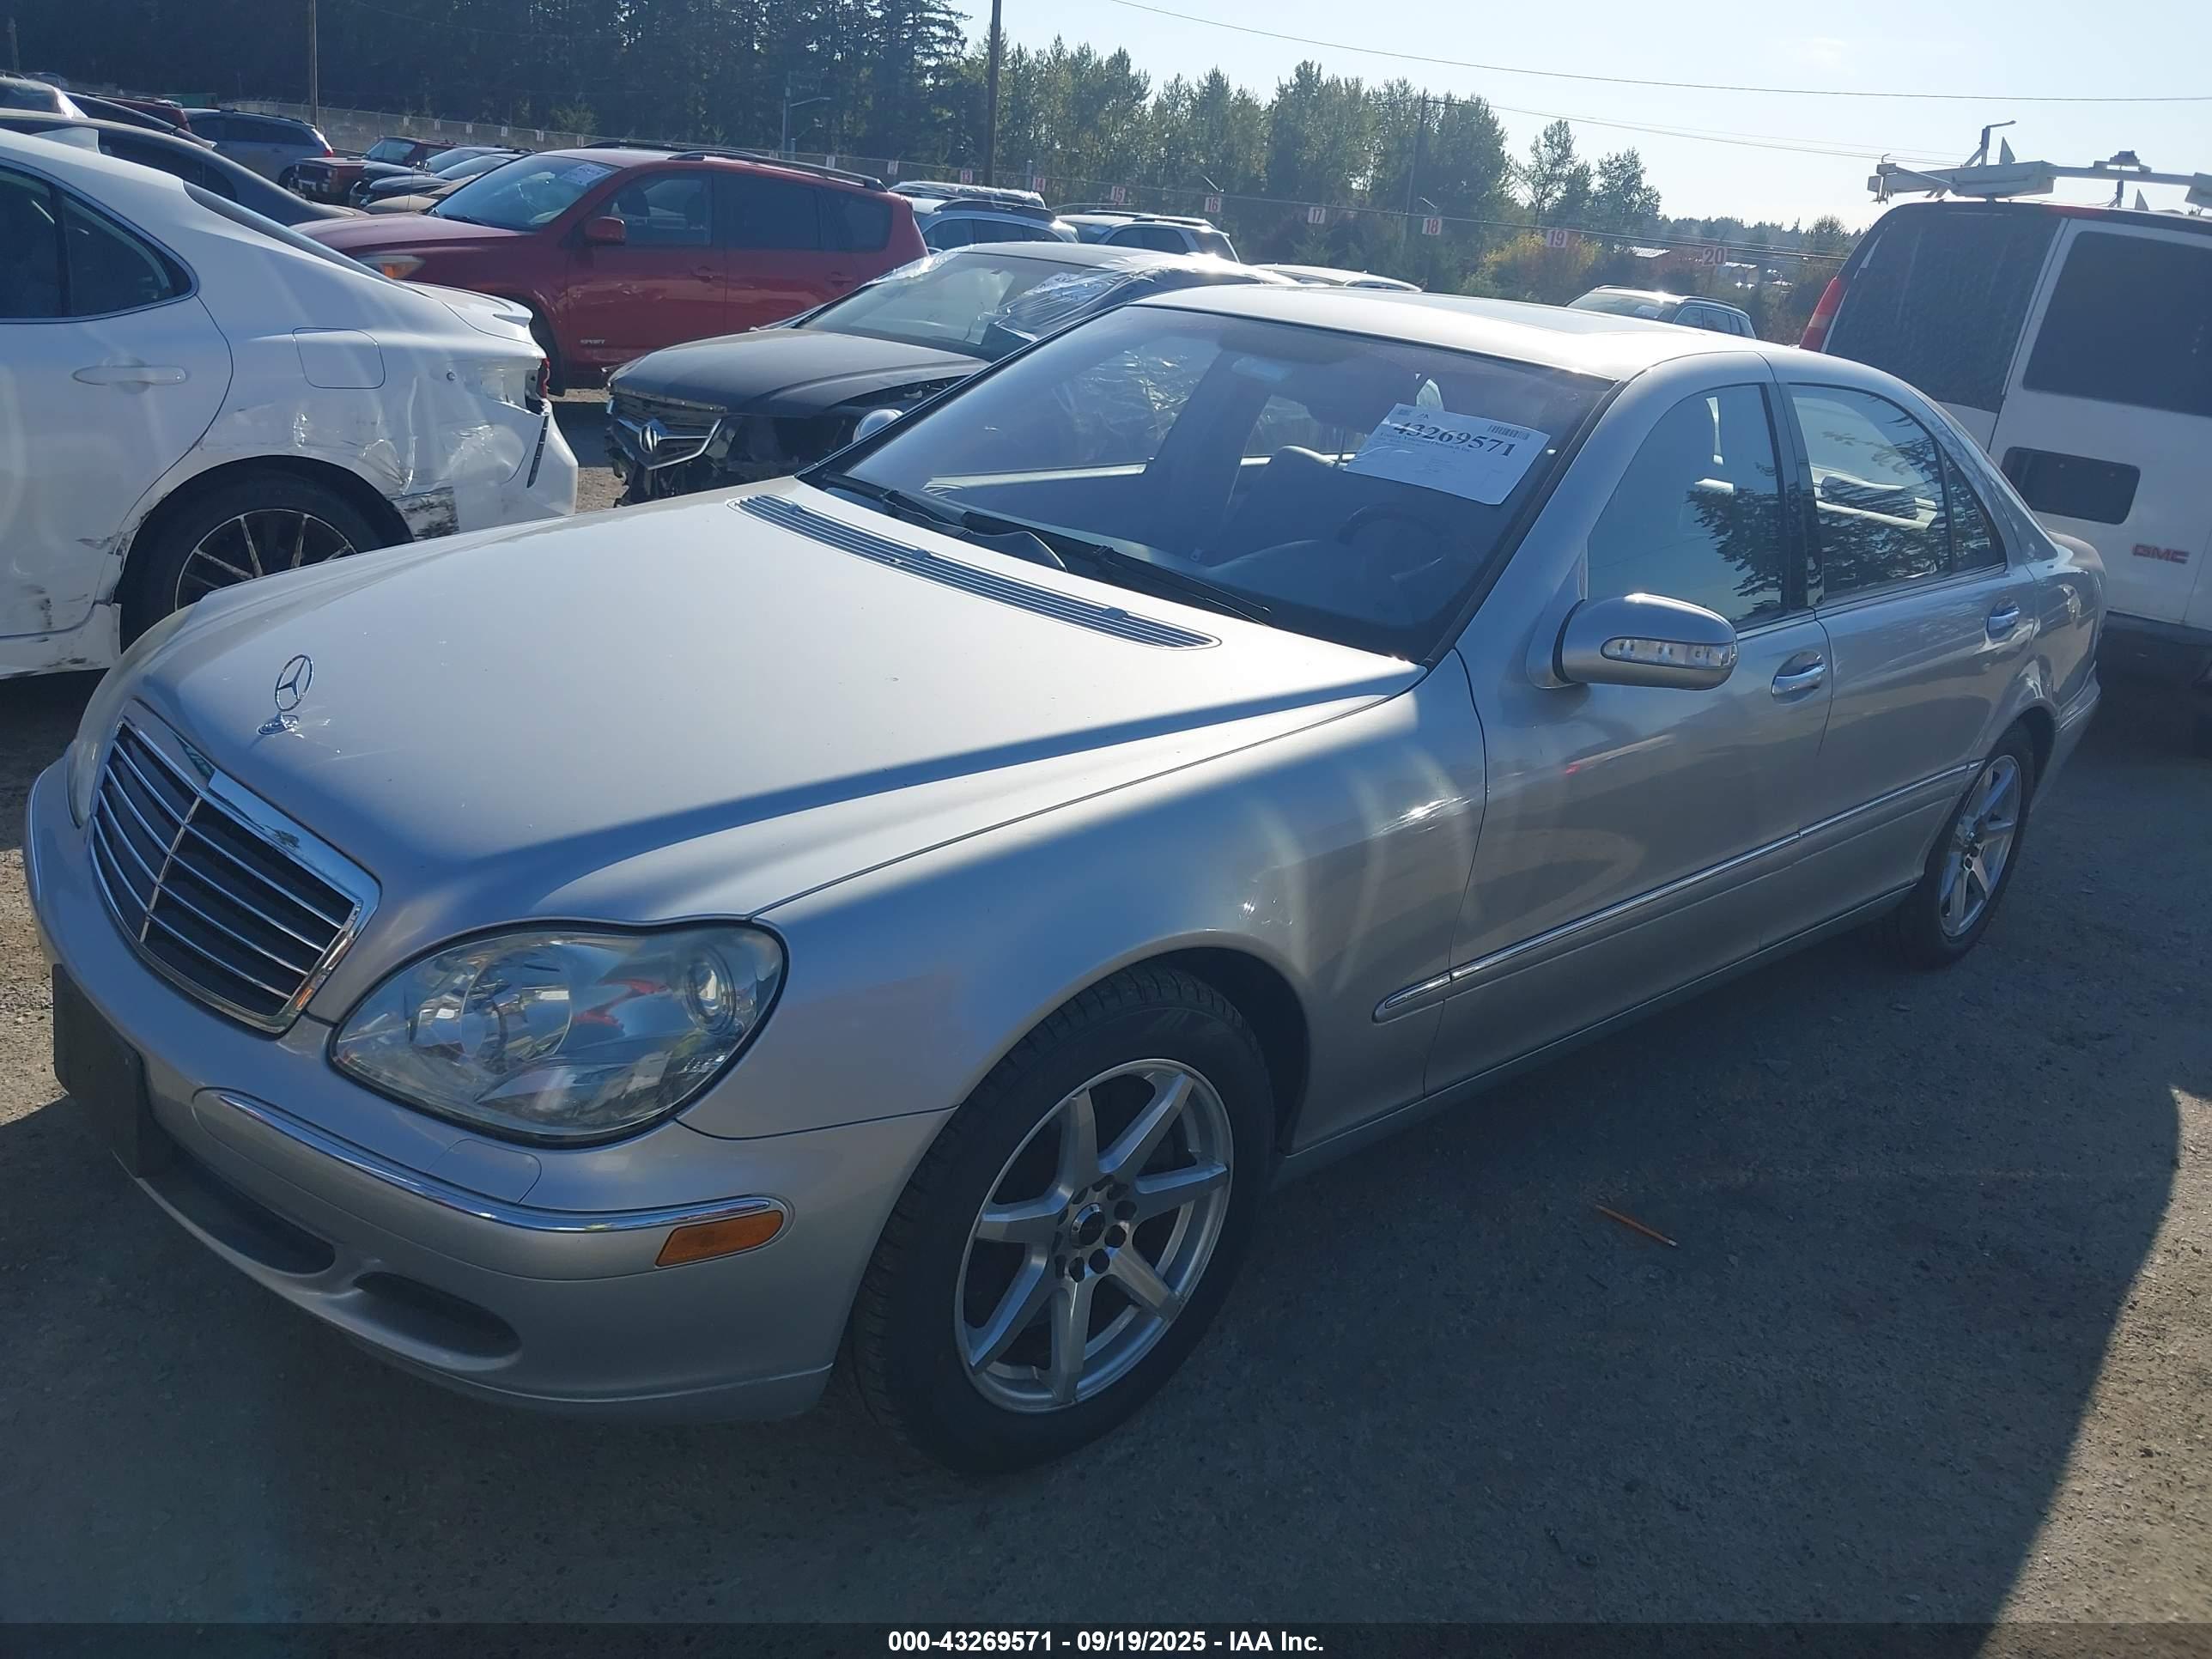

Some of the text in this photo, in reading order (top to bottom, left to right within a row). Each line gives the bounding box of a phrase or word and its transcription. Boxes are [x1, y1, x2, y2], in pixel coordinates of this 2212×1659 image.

[1113, 188, 1124, 202] 15
[1208, 198, 1218, 212] 16
[1311, 209, 1323, 222] 17
[1426, 219, 1439, 234] 18
[1549, 231, 1565, 247] 19
[1703, 247, 1726, 265] 20
[1394, 422, 1516, 457] 43269571
[2131, 543, 2190, 564] GMC
